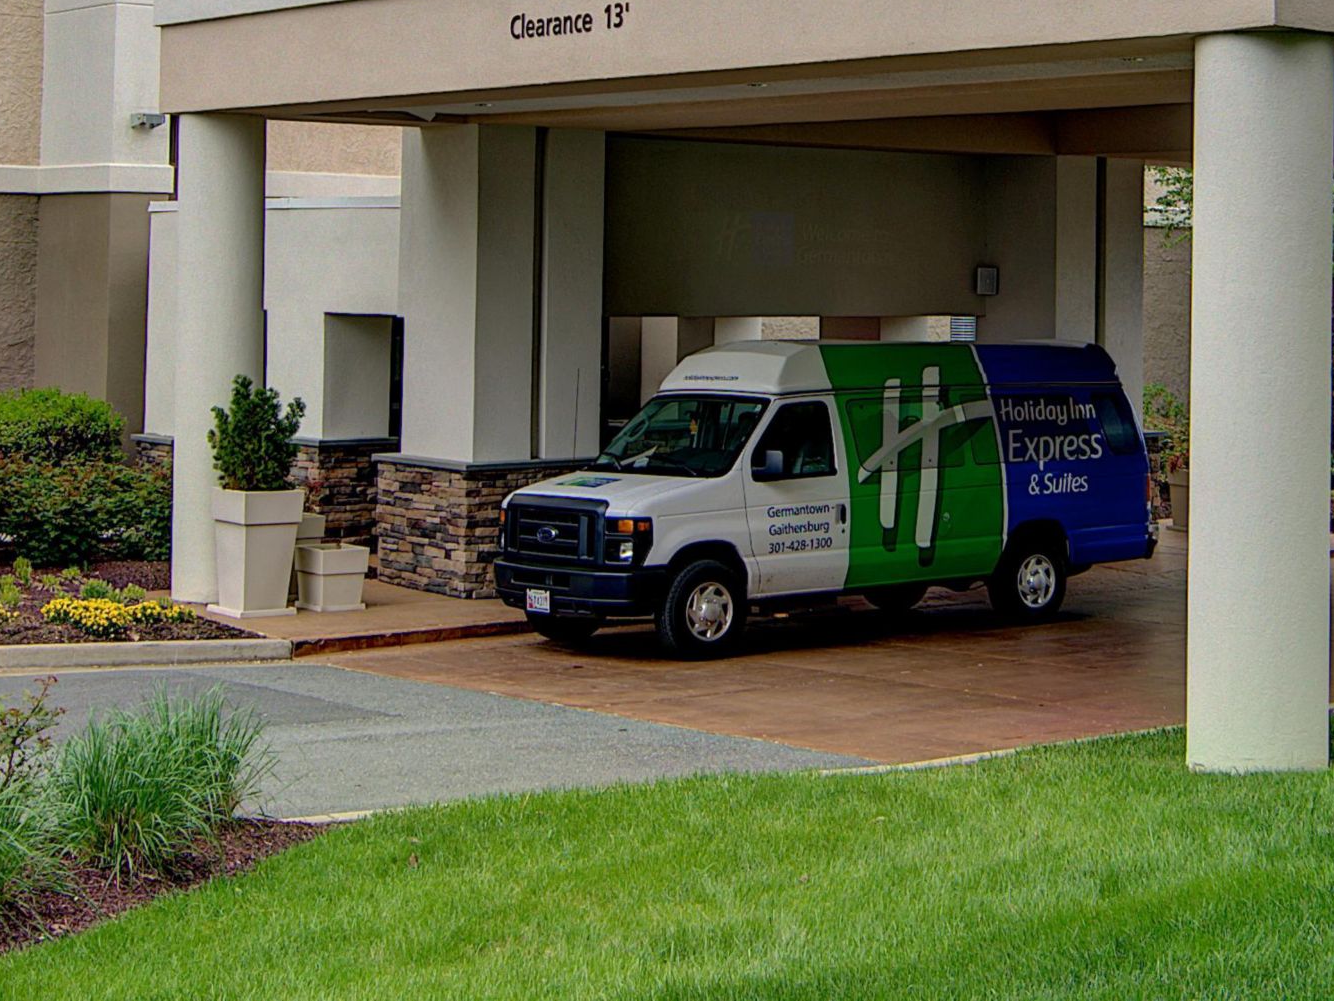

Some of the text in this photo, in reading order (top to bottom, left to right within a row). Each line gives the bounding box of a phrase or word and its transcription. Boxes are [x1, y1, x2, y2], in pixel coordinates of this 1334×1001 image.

[510, 2, 629, 39] Clearance 13'
[1000, 397, 1096, 425] Holiday Inn
[1008, 429, 1103, 471] Express
[1028, 472, 1088, 495] & Suites
[767, 504, 830, 518] Germantown
[769, 521, 830, 536] Gaithersburg
[768, 537, 833, 554] 301-428-1300
